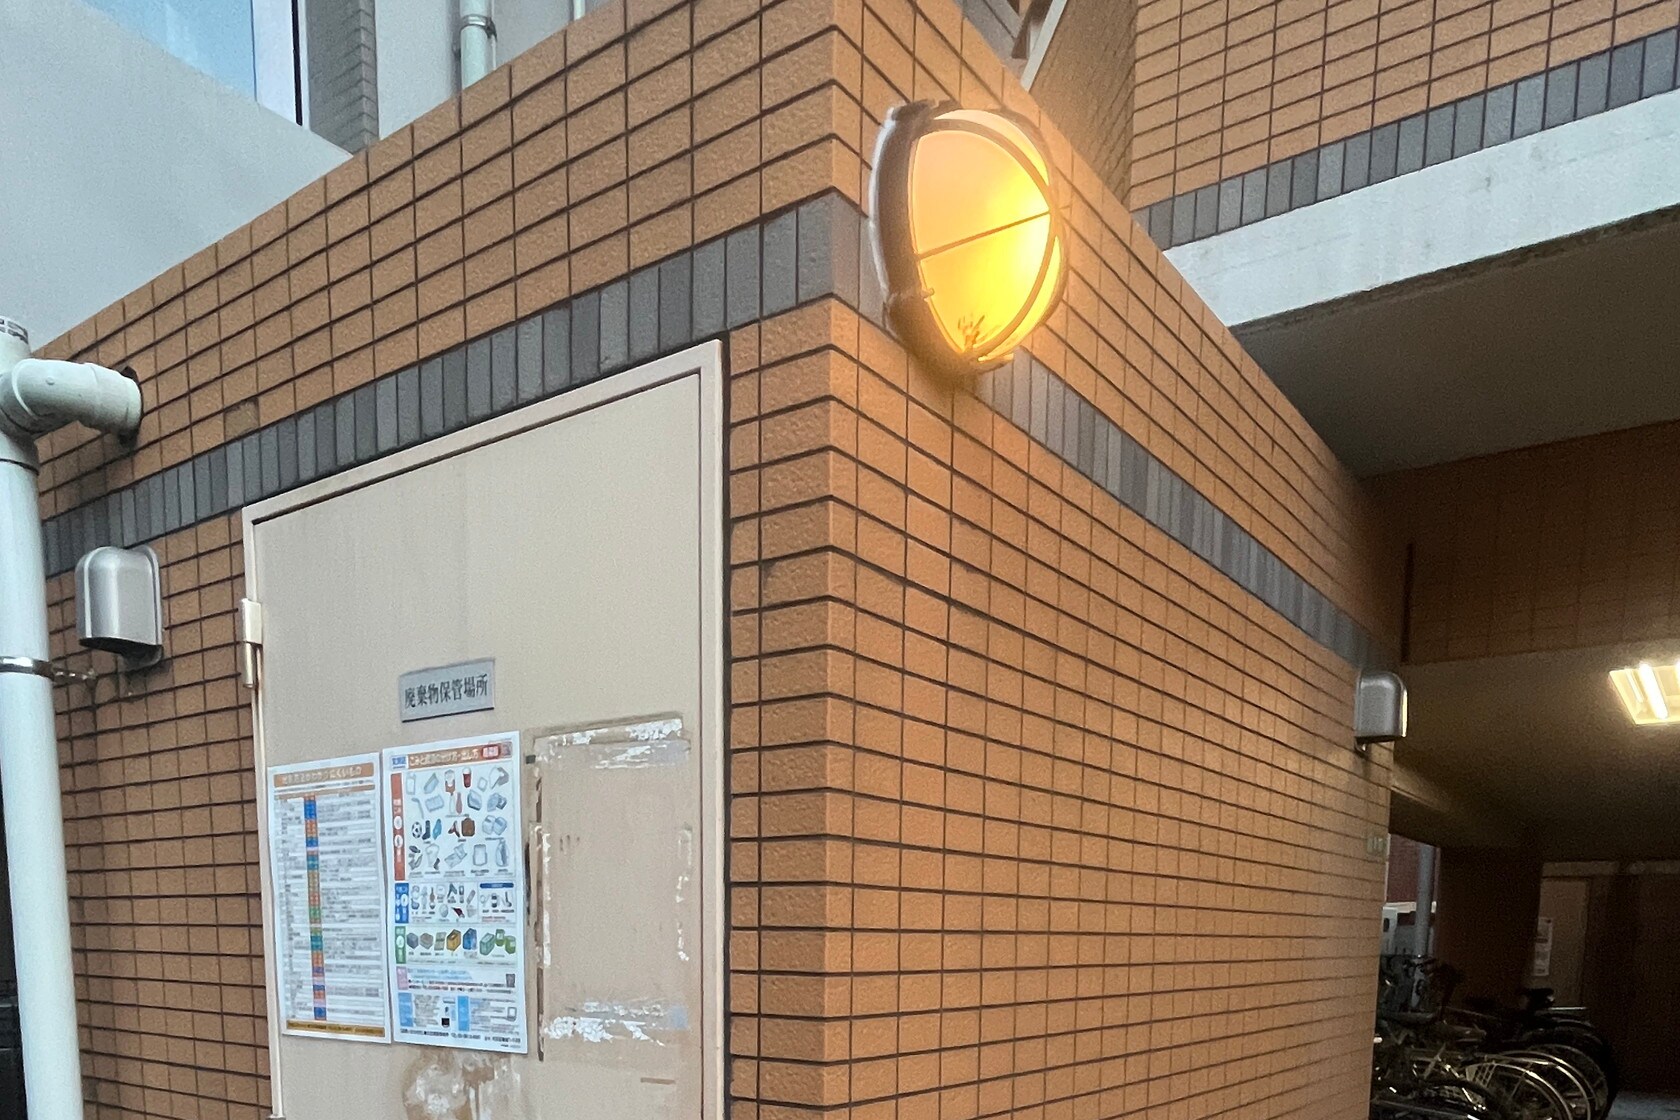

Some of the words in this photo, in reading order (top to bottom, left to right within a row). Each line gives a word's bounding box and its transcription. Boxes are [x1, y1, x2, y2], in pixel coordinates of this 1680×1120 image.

[404, 673, 488, 709] 廃棄物保管場所
